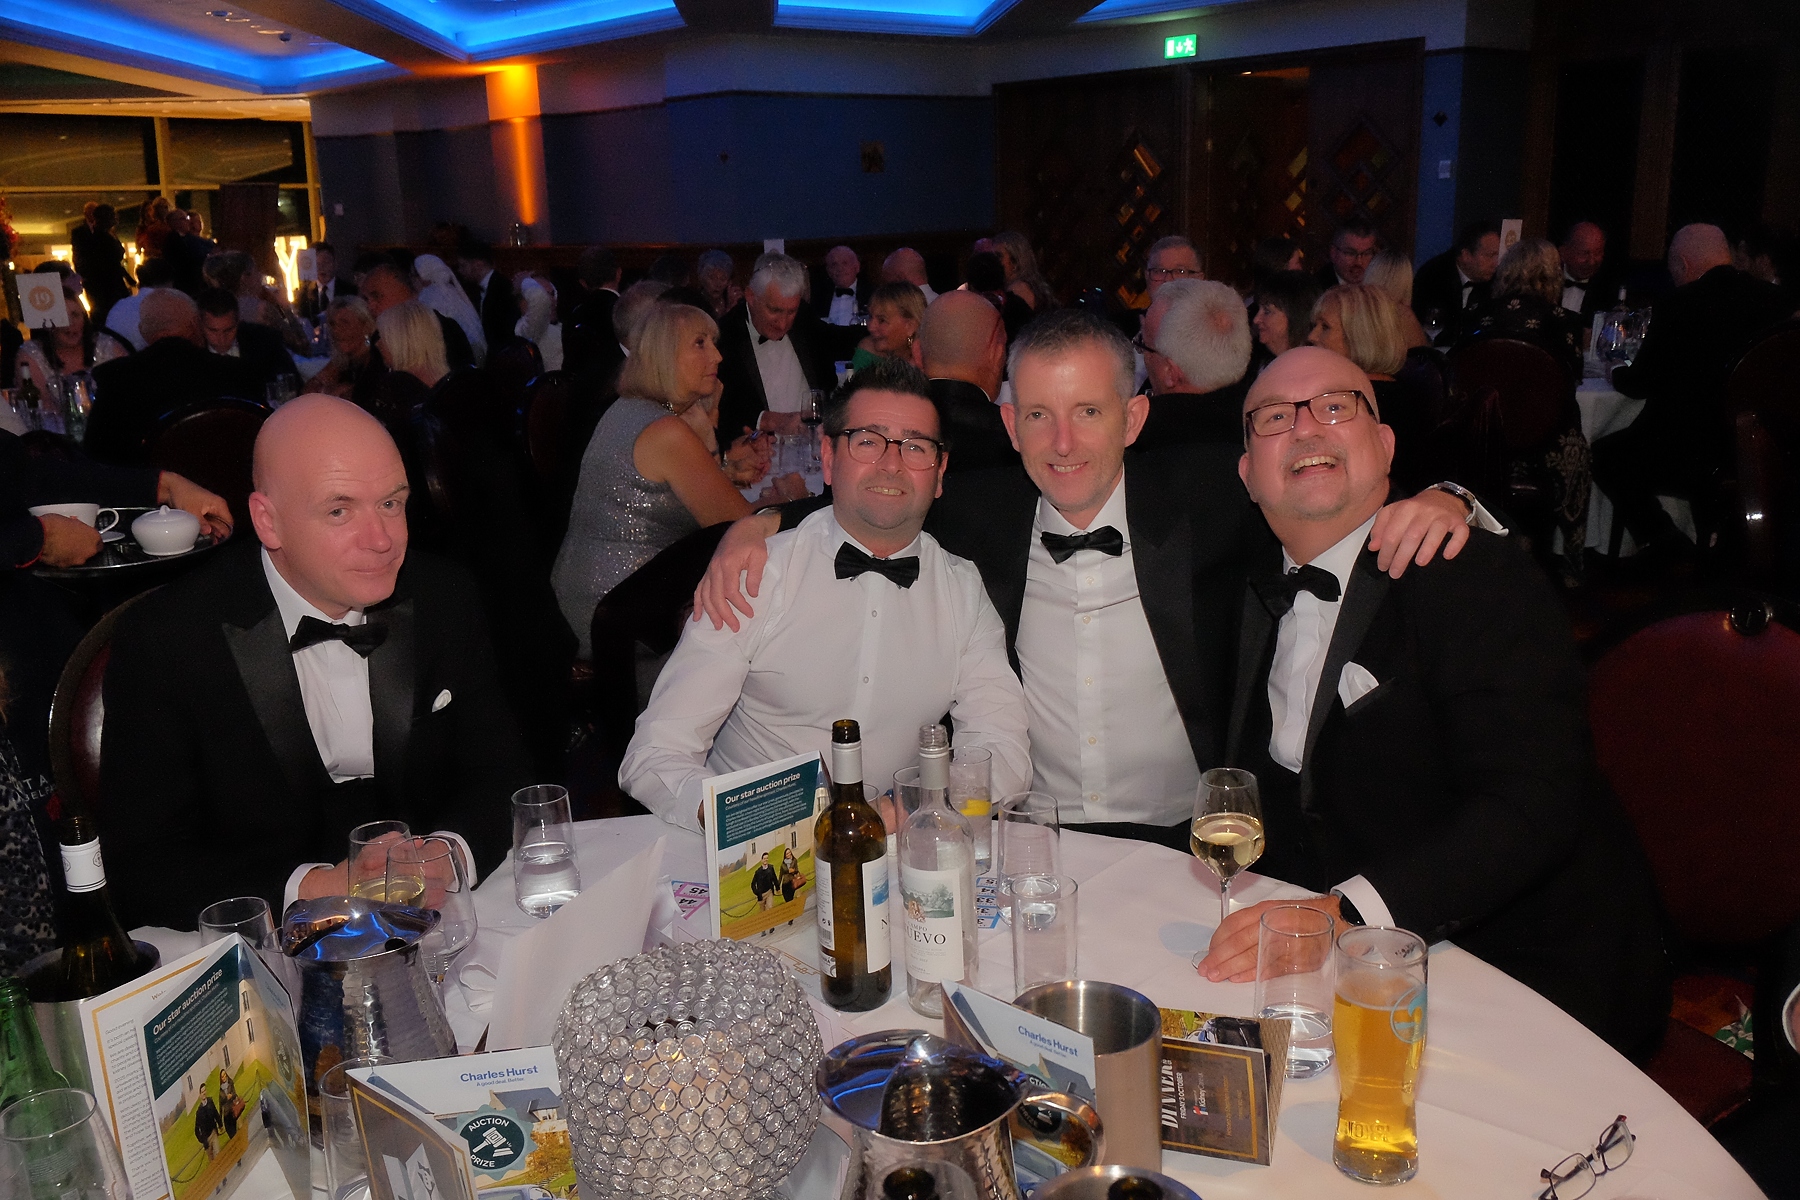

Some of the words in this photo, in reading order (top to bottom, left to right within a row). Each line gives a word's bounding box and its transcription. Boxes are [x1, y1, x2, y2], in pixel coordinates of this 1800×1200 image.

[35, 292, 50, 305] 19
[725, 794, 740, 804] Our
[740, 788, 755, 800] star
[756, 778, 783, 794] auction
[783, 772, 801, 786] prize
[689, 887, 708, 895] 45
[153, 1019, 167, 1035] Our
[167, 1005, 182, 1023] star
[182, 983, 207, 1010] auction
[207, 968, 223, 990] prize
[1018, 1025, 1052, 1046] Charles
[1053, 1039, 1079, 1057] Hurst
[460, 1070, 505, 1082] Charles
[506, 1065, 538, 1077] Hurst
[1176, 1072, 1185, 1097] OCTOBER
[1179, 1100, 1187, 1120] FRIDAY
[468, 1117, 510, 1132] AUCTION
[470, 1154, 495, 1168] PRIZE
